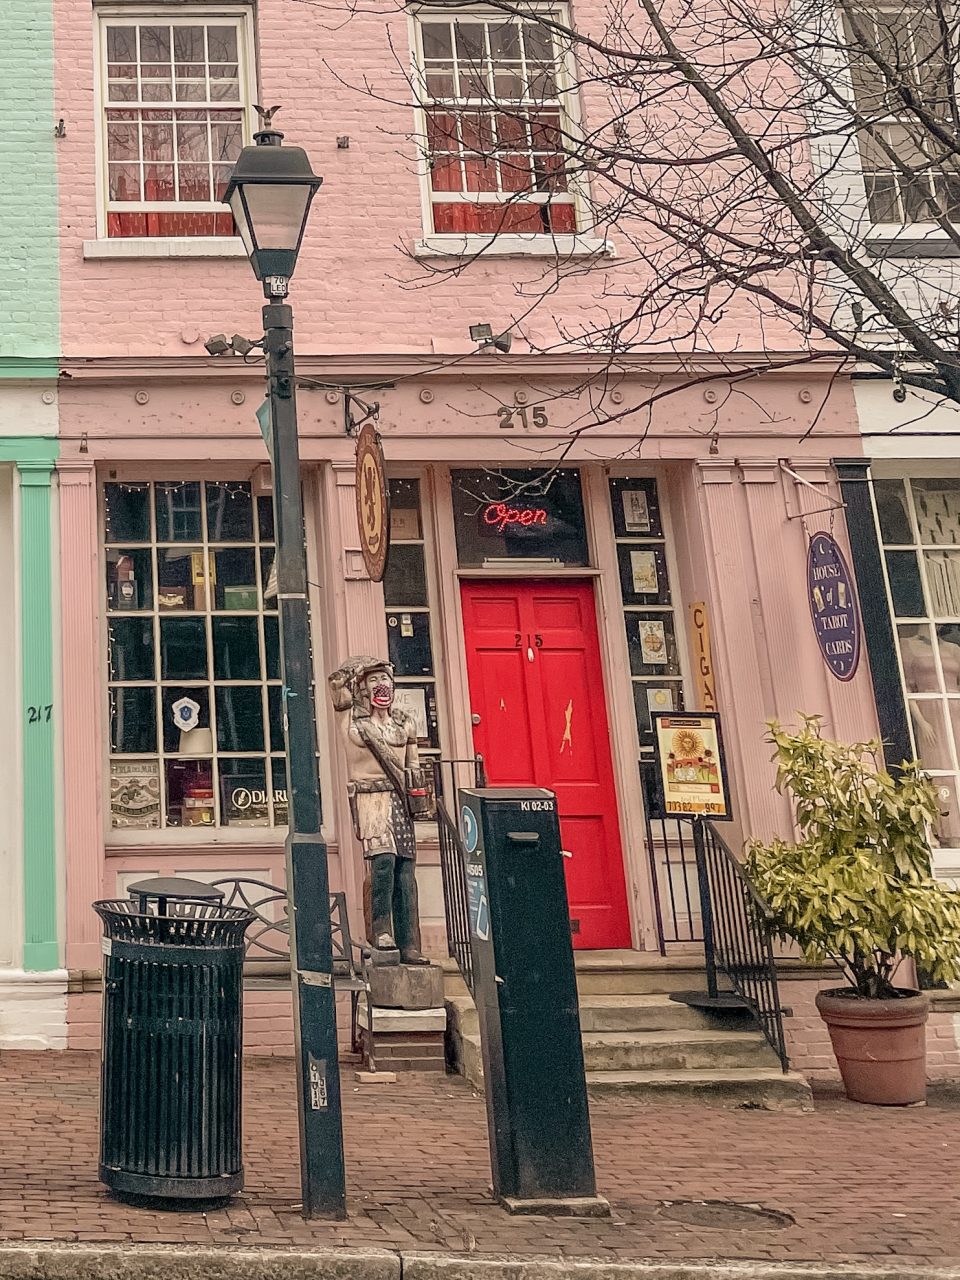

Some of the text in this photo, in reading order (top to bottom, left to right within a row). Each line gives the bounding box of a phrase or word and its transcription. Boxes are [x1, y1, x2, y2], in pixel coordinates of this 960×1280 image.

[271, 284, 286, 292] LED
[273, 276, 284, 284] 70
[497, 406, 549, 429] 215
[484, 503, 547, 532] Open
[813, 563, 841, 581] HOUSE
[826, 587, 834, 606] of
[820, 613, 849, 630] TAROT
[514, 633, 544, 648] 215
[825, 639, 853, 656] CARDS
[27, 703, 54, 725] 217
[521, 802, 554, 811] KI 02-03
